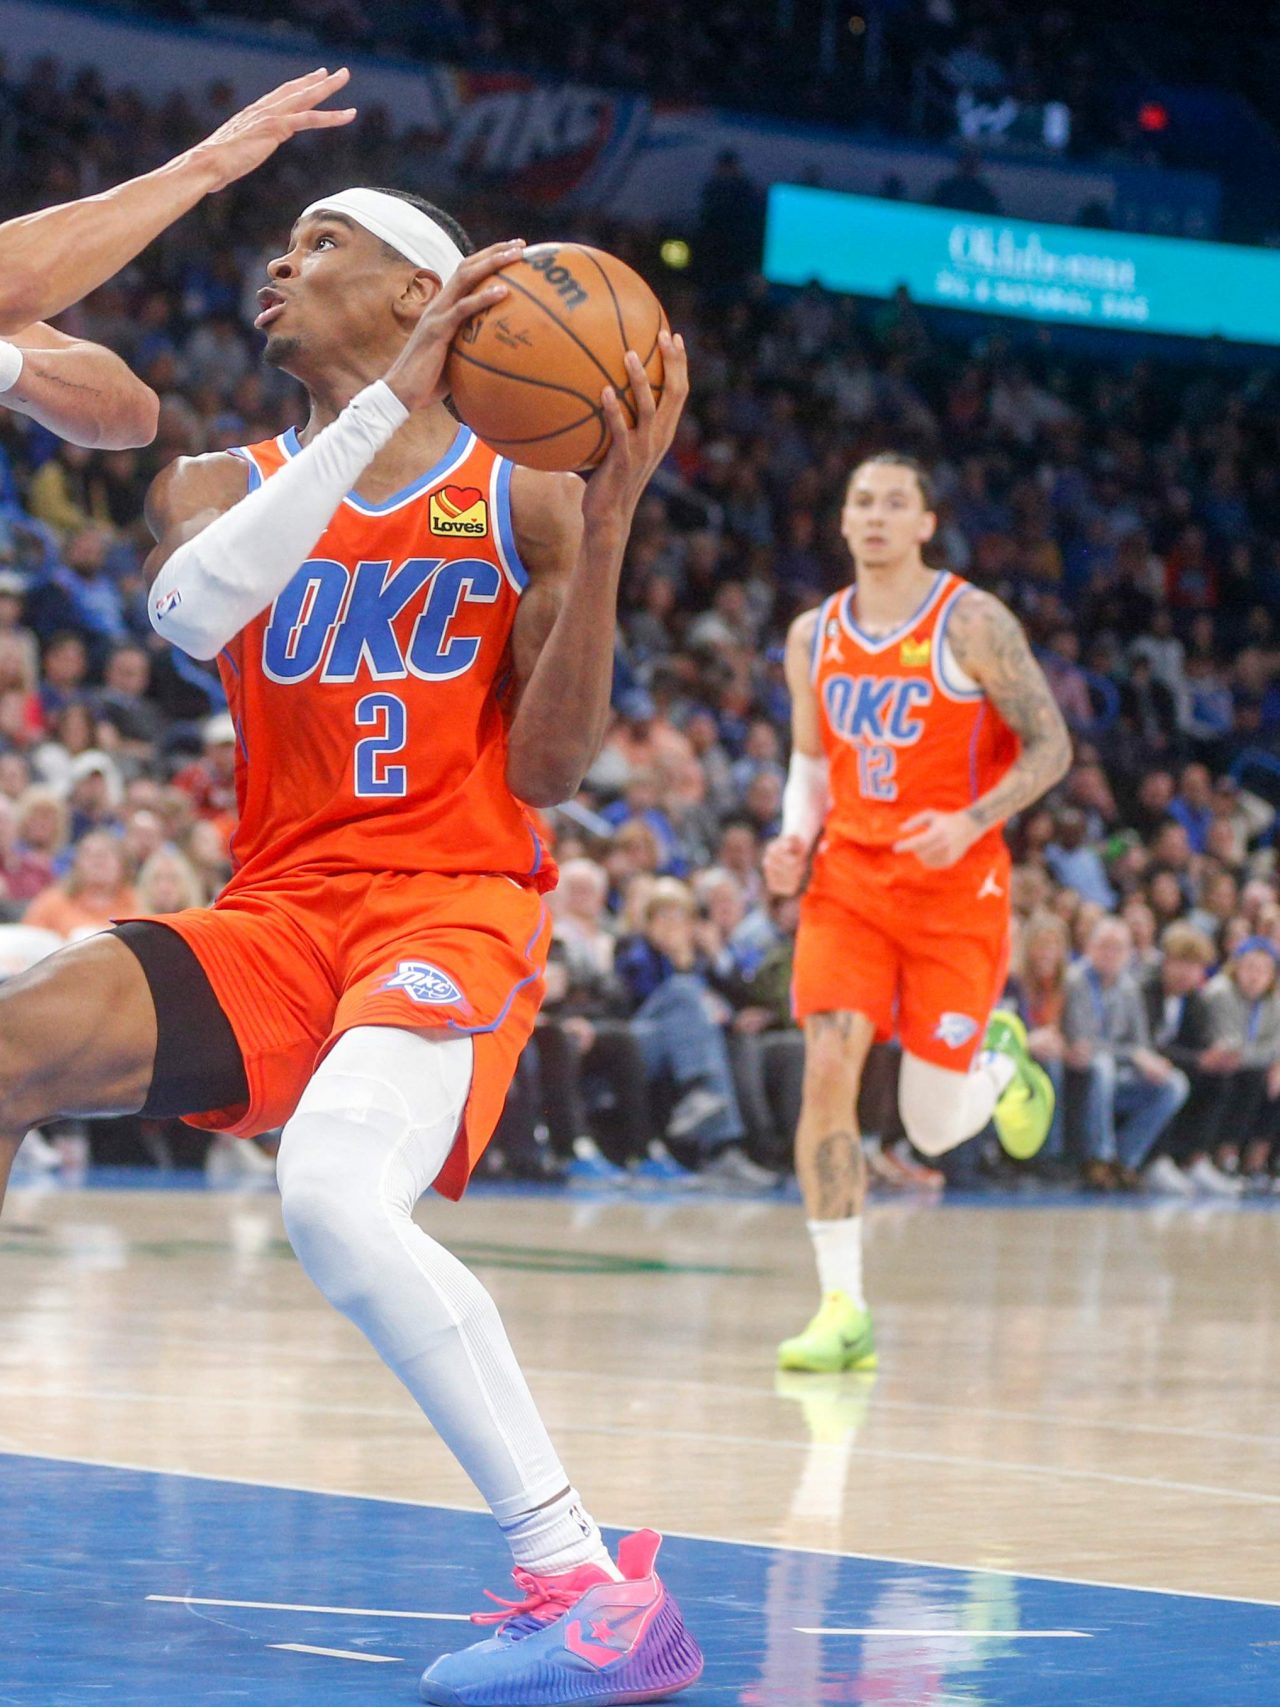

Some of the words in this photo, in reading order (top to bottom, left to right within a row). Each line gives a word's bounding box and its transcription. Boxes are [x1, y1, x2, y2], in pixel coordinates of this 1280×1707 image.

[262, 558, 502, 685] OKC
[354, 692, 407, 797] 2
[823, 673, 933, 747] OKC
[858, 743, 899, 802] 12
